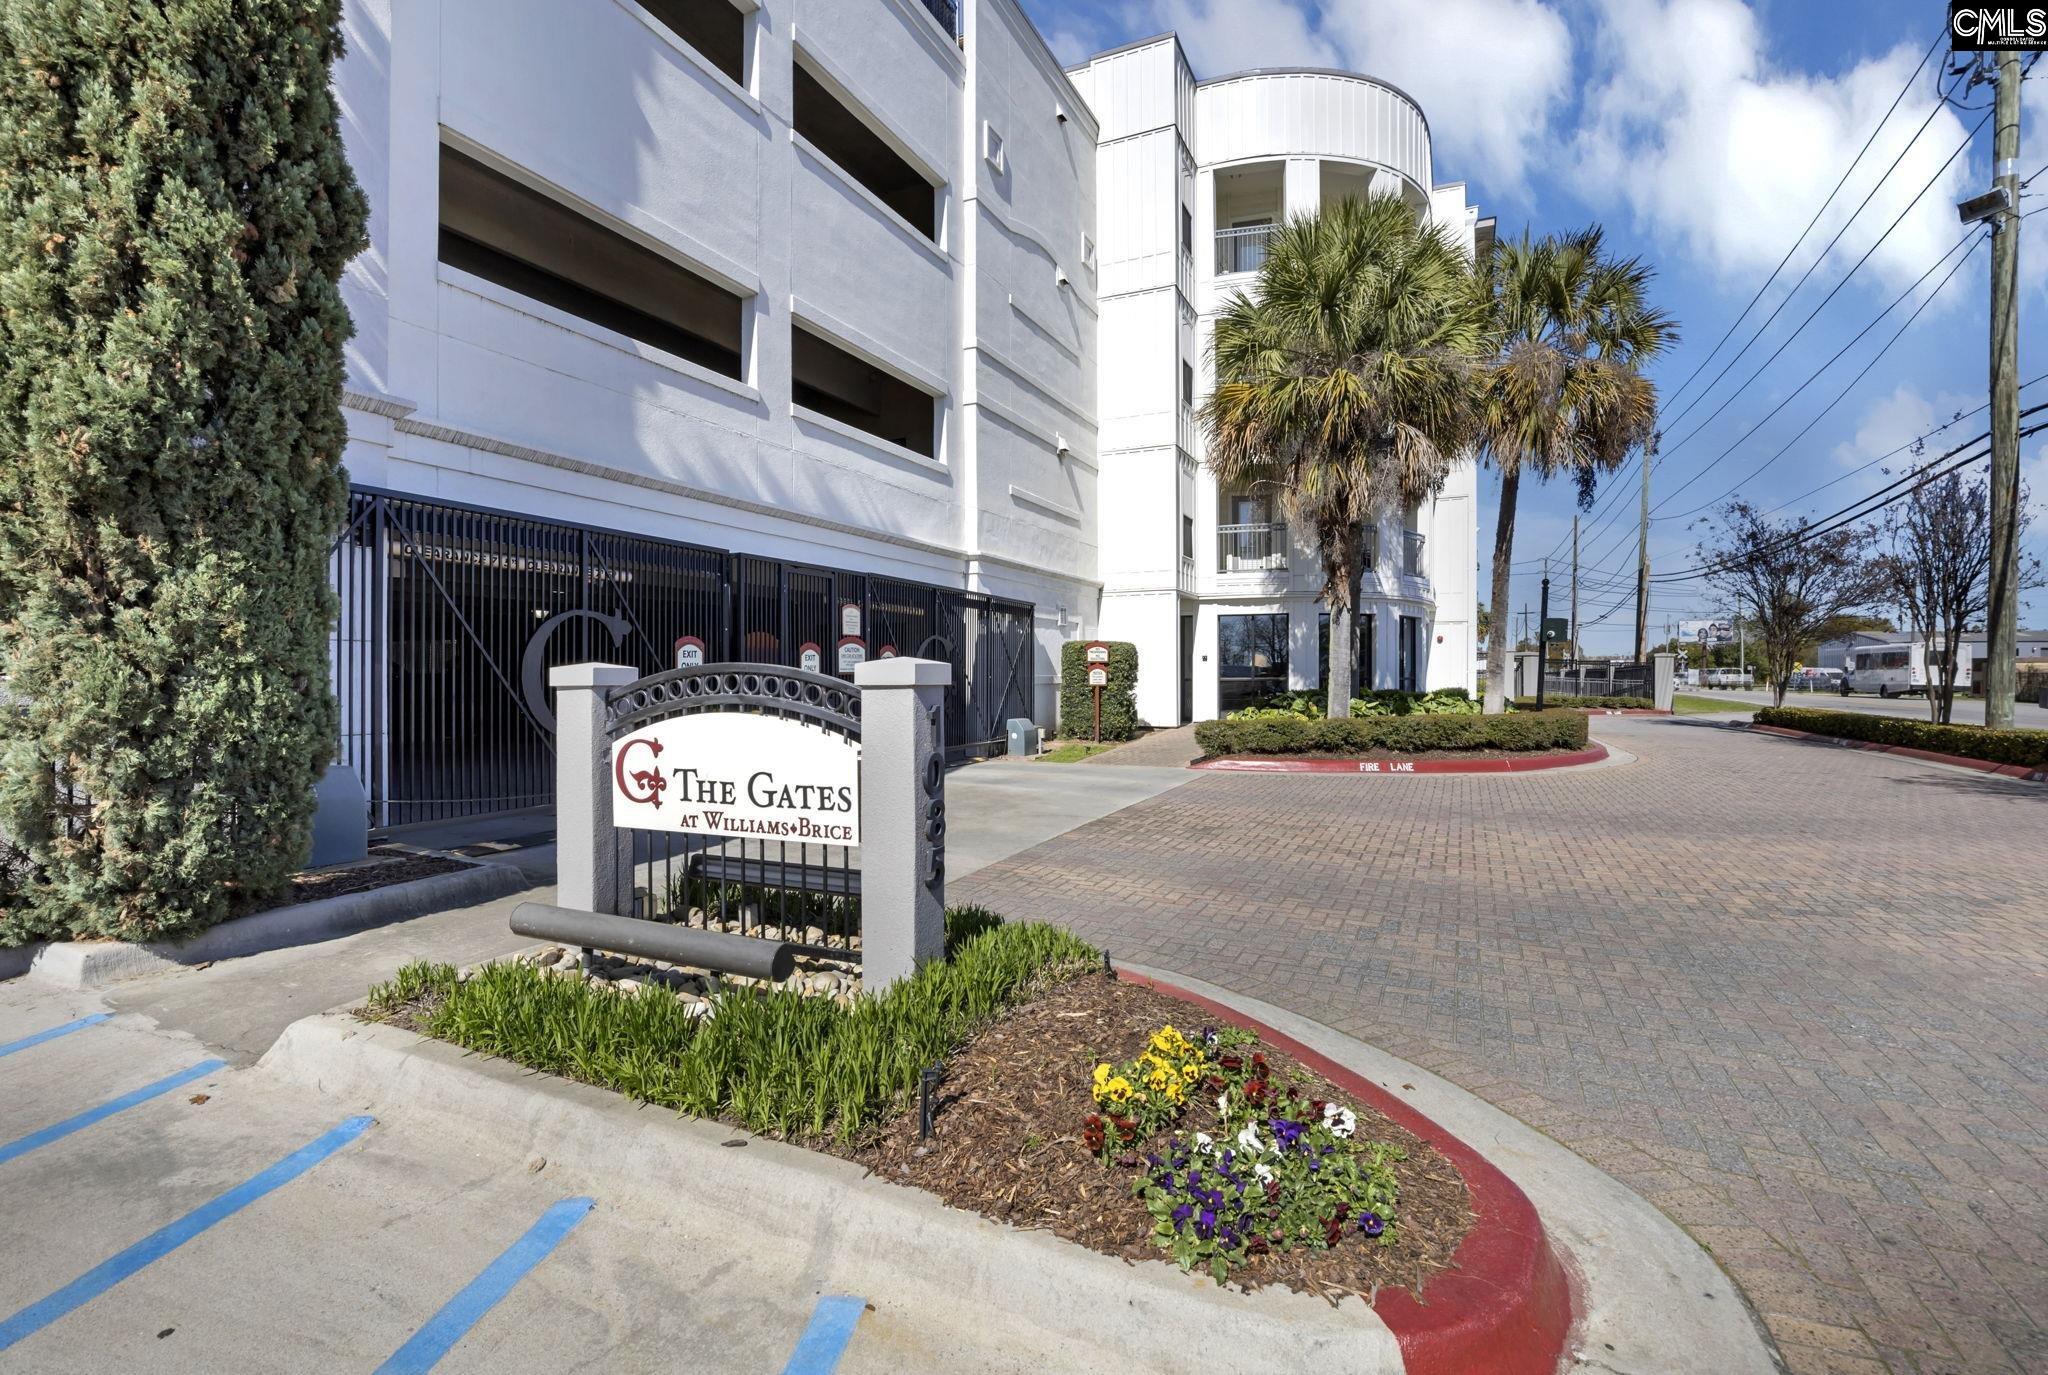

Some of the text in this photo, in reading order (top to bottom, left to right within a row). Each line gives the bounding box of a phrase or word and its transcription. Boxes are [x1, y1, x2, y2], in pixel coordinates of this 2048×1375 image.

[682, 650, 698, 658] EXIT
[1360, 762, 1415, 772] FIRE LANE
[673, 768, 853, 813] THE GATES
[922, 704, 946, 890] 1085
[680, 814, 699, 828] AT
